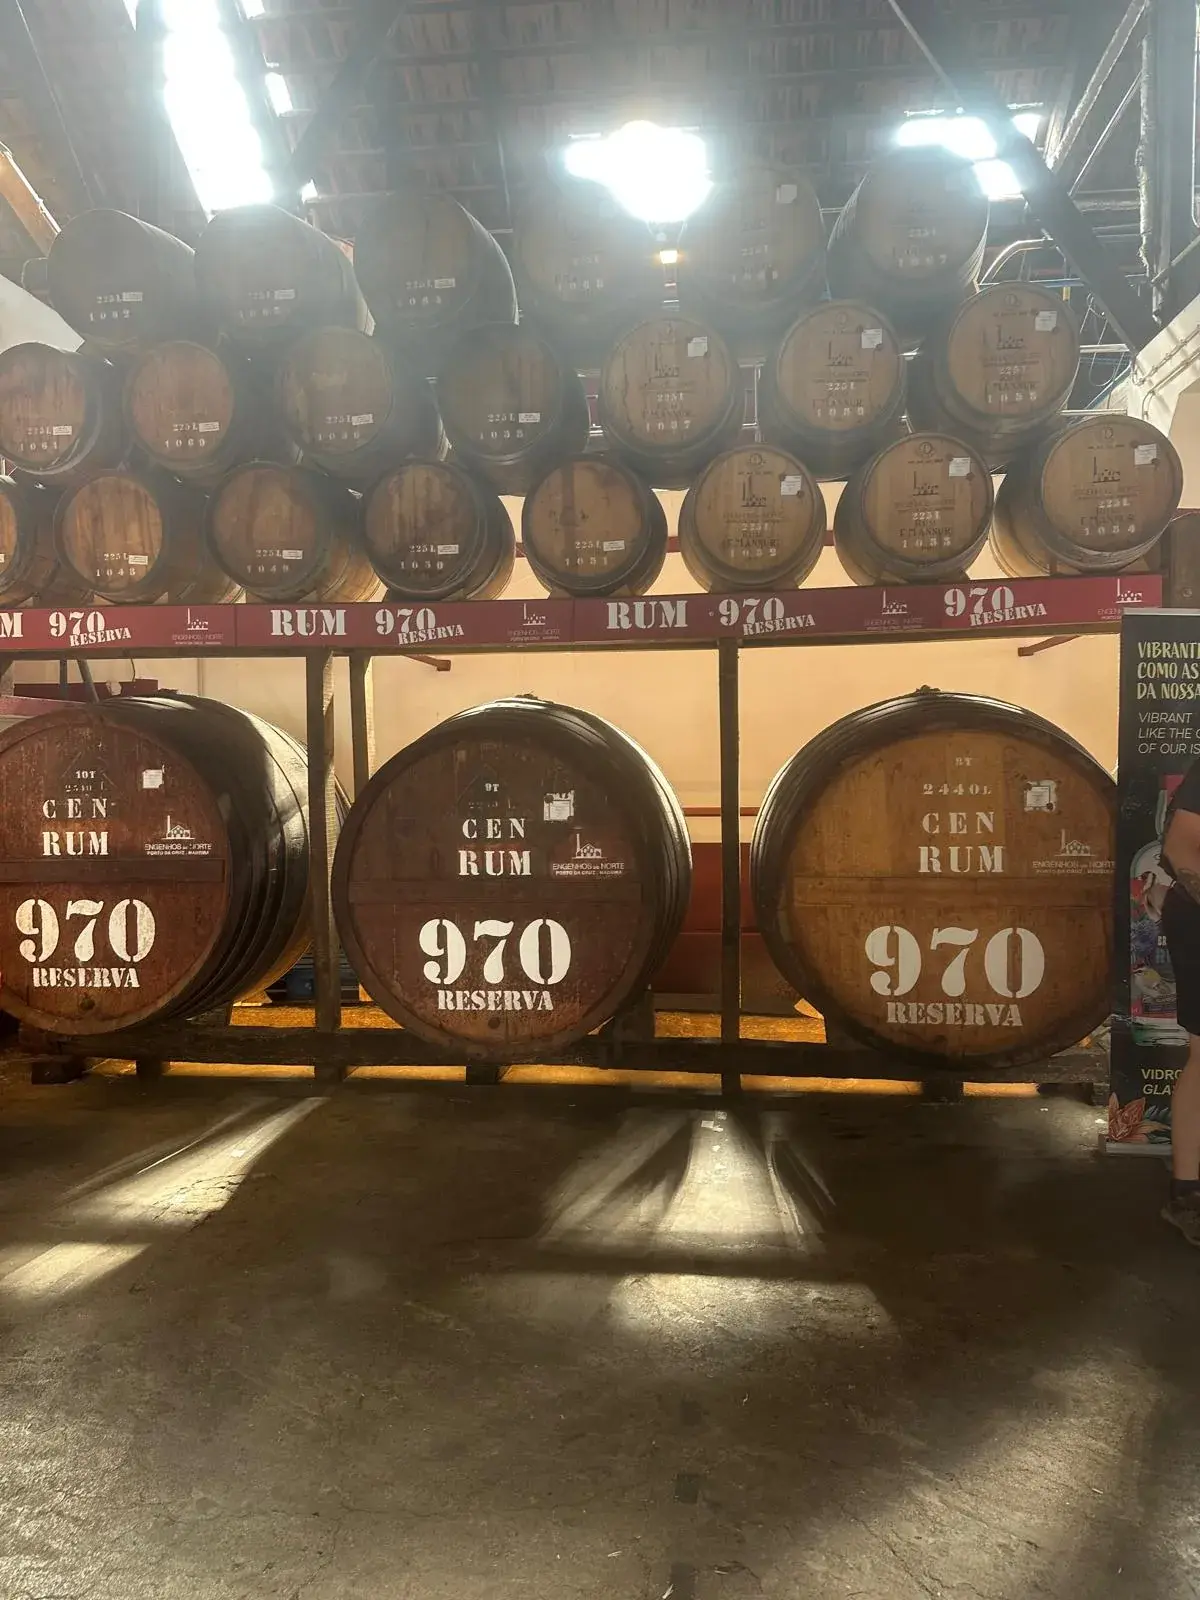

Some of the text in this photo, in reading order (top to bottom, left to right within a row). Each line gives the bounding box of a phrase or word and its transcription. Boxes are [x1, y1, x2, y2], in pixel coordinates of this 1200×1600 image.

[943, 586, 1015, 617] 970
[270, 608, 437, 636] RUM 970
[606, 597, 785, 629] RUM 970
[969, 603, 1048, 627] RESERVA
[48, 611, 106, 637] 970
[397, 624, 465, 645] RESERVA
[742, 614, 816, 636] RESERVA
[69, 627, 132, 648] RESERVA
[1137, 662, 1178, 679] COMO
[1137, 682, 1156, 700] DA
[1138, 712, 1193, 723] VIBRANT
[1138, 727, 1166, 739] LIKE
[1169, 727, 1192, 739] THE
[1138, 743, 1157, 754] OF
[1160, 743, 1187, 754] OUR
[42, 798, 108, 819] CEN
[462, 818, 526, 839] CEN
[922, 811, 995, 834] CEN
[42, 831, 108, 856] RUM
[144, 843, 182, 851] ENGENHOS
[458, 850, 532, 876] RUM
[600, 862, 625, 870] NORTE
[918, 845, 1005, 873] RUM
[15, 899, 156, 962] 970
[418, 918, 572, 985] 970
[864, 925, 1045, 999] 970
[32, 967, 140, 988] RESERVA
[437, 990, 554, 1011] RESERVA
[886, 1002, 1023, 1027] RESERVA
[1143, 1084, 1173, 1095] GLA
